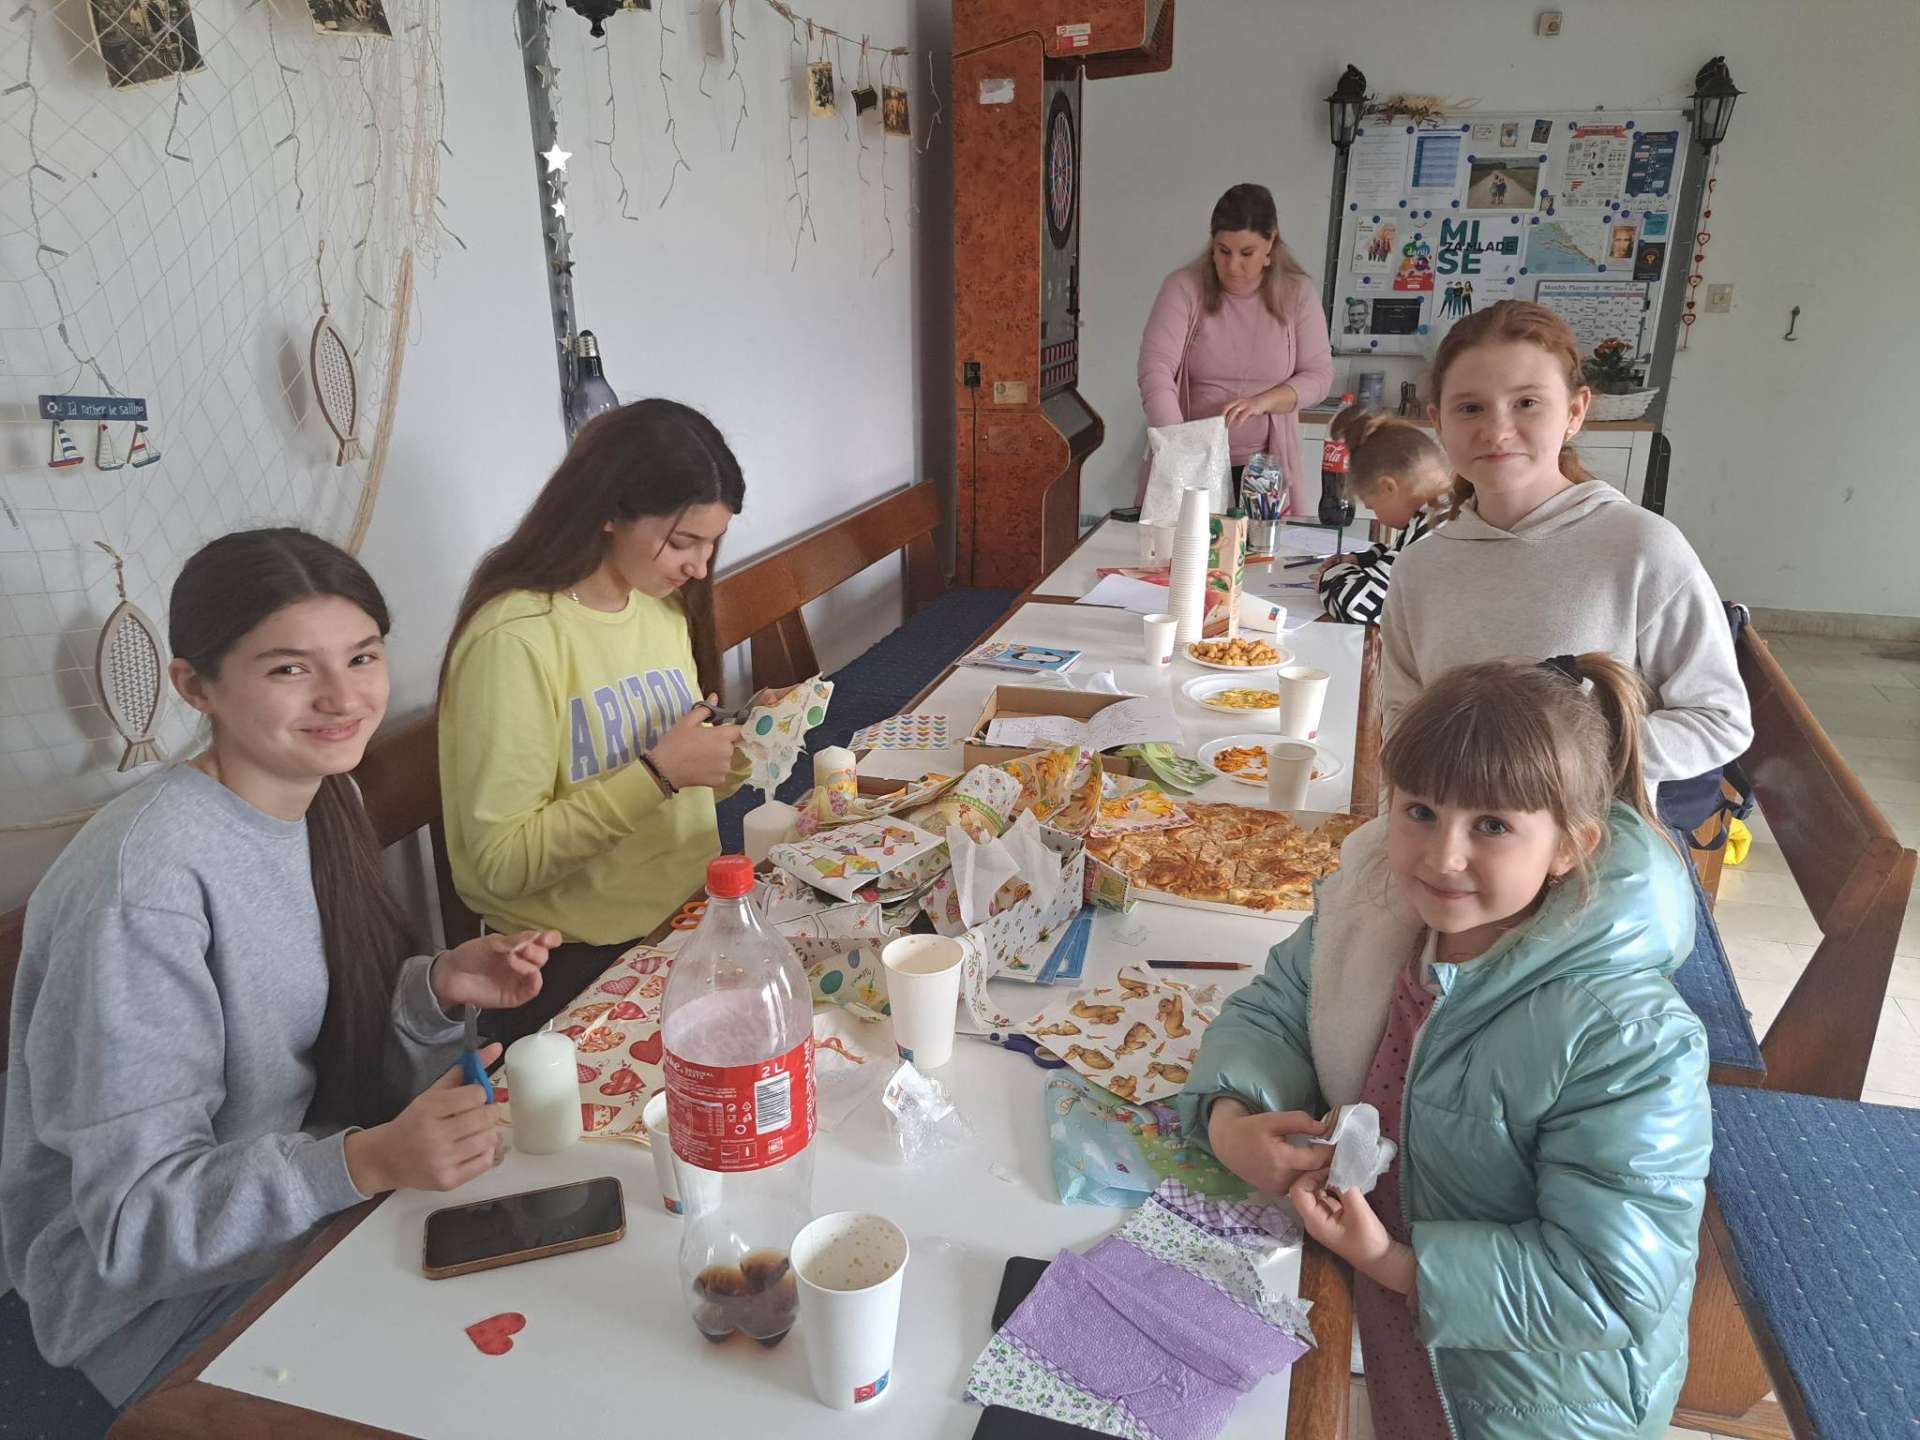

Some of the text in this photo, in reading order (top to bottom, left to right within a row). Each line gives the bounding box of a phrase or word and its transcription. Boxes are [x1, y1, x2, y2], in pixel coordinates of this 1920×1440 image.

[1440, 218, 1480, 247] MI
[1437, 248, 1481, 275] SE
[761, 1063, 783, 1078] 2 L
